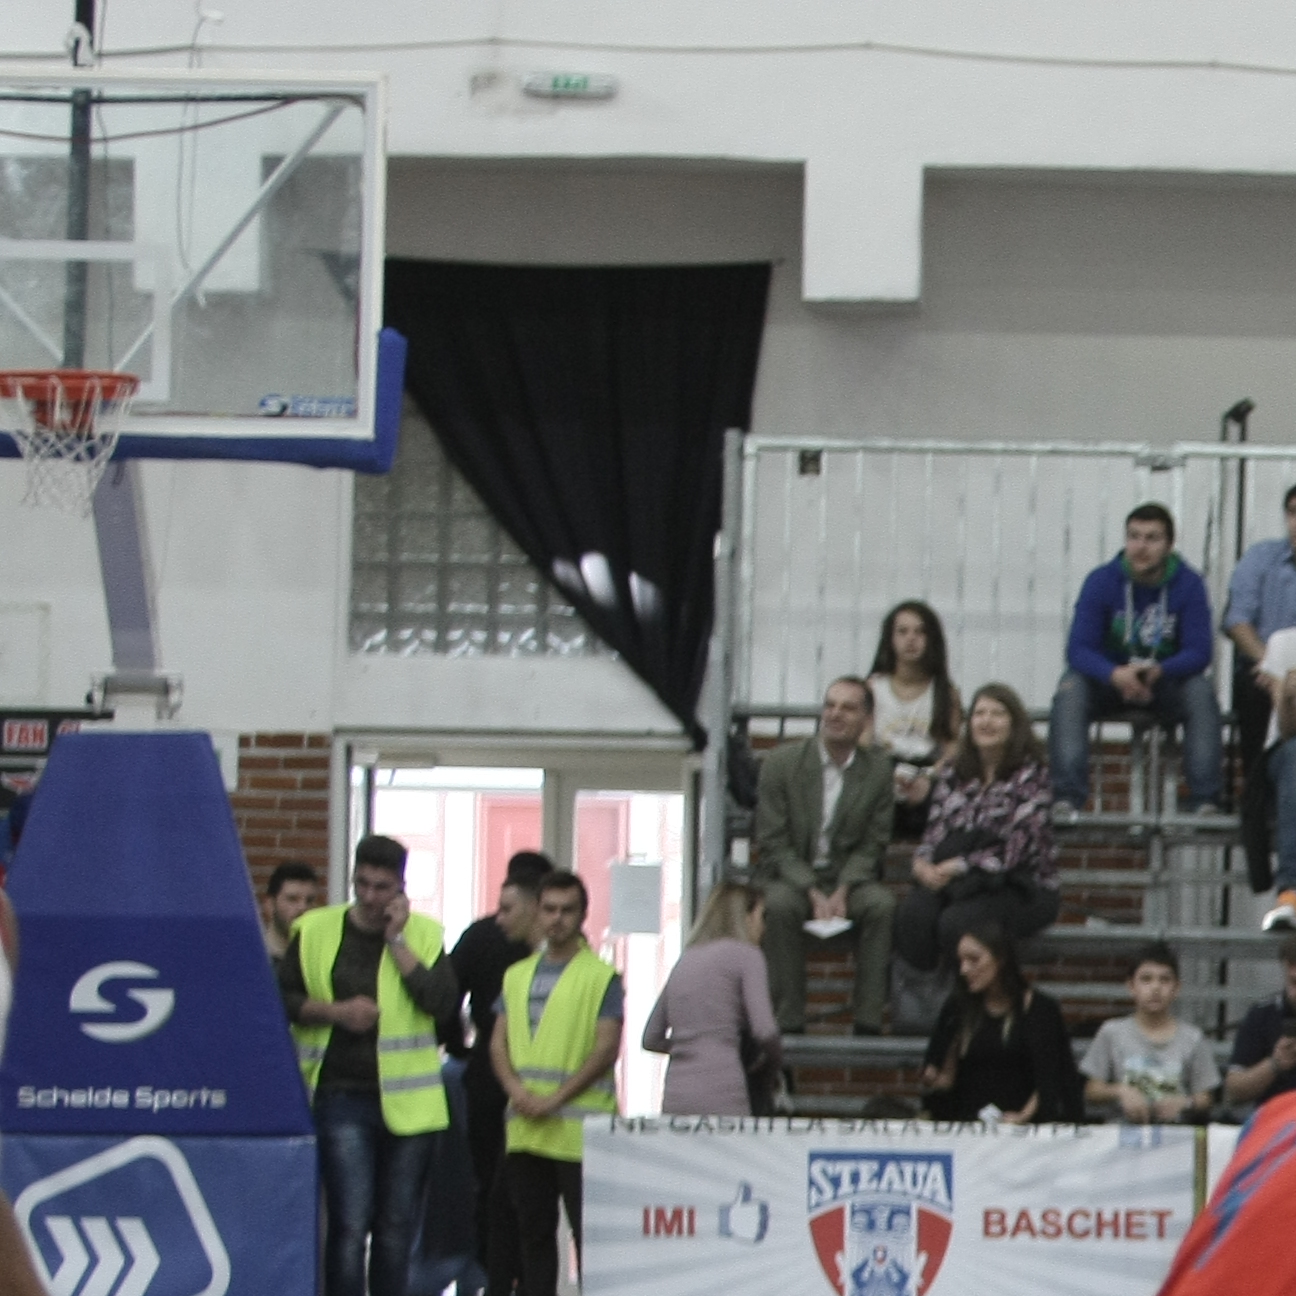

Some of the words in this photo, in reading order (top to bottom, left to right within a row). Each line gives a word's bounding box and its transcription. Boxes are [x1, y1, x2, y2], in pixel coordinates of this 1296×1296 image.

[17, 1086, 130, 1110] Schelde
[135, 1086, 227, 1114] Sports
[809, 1157, 953, 1208] STEAUA
[642, 1206, 696, 1239] IMI
[982, 1208, 1173, 1242] BASCHET
